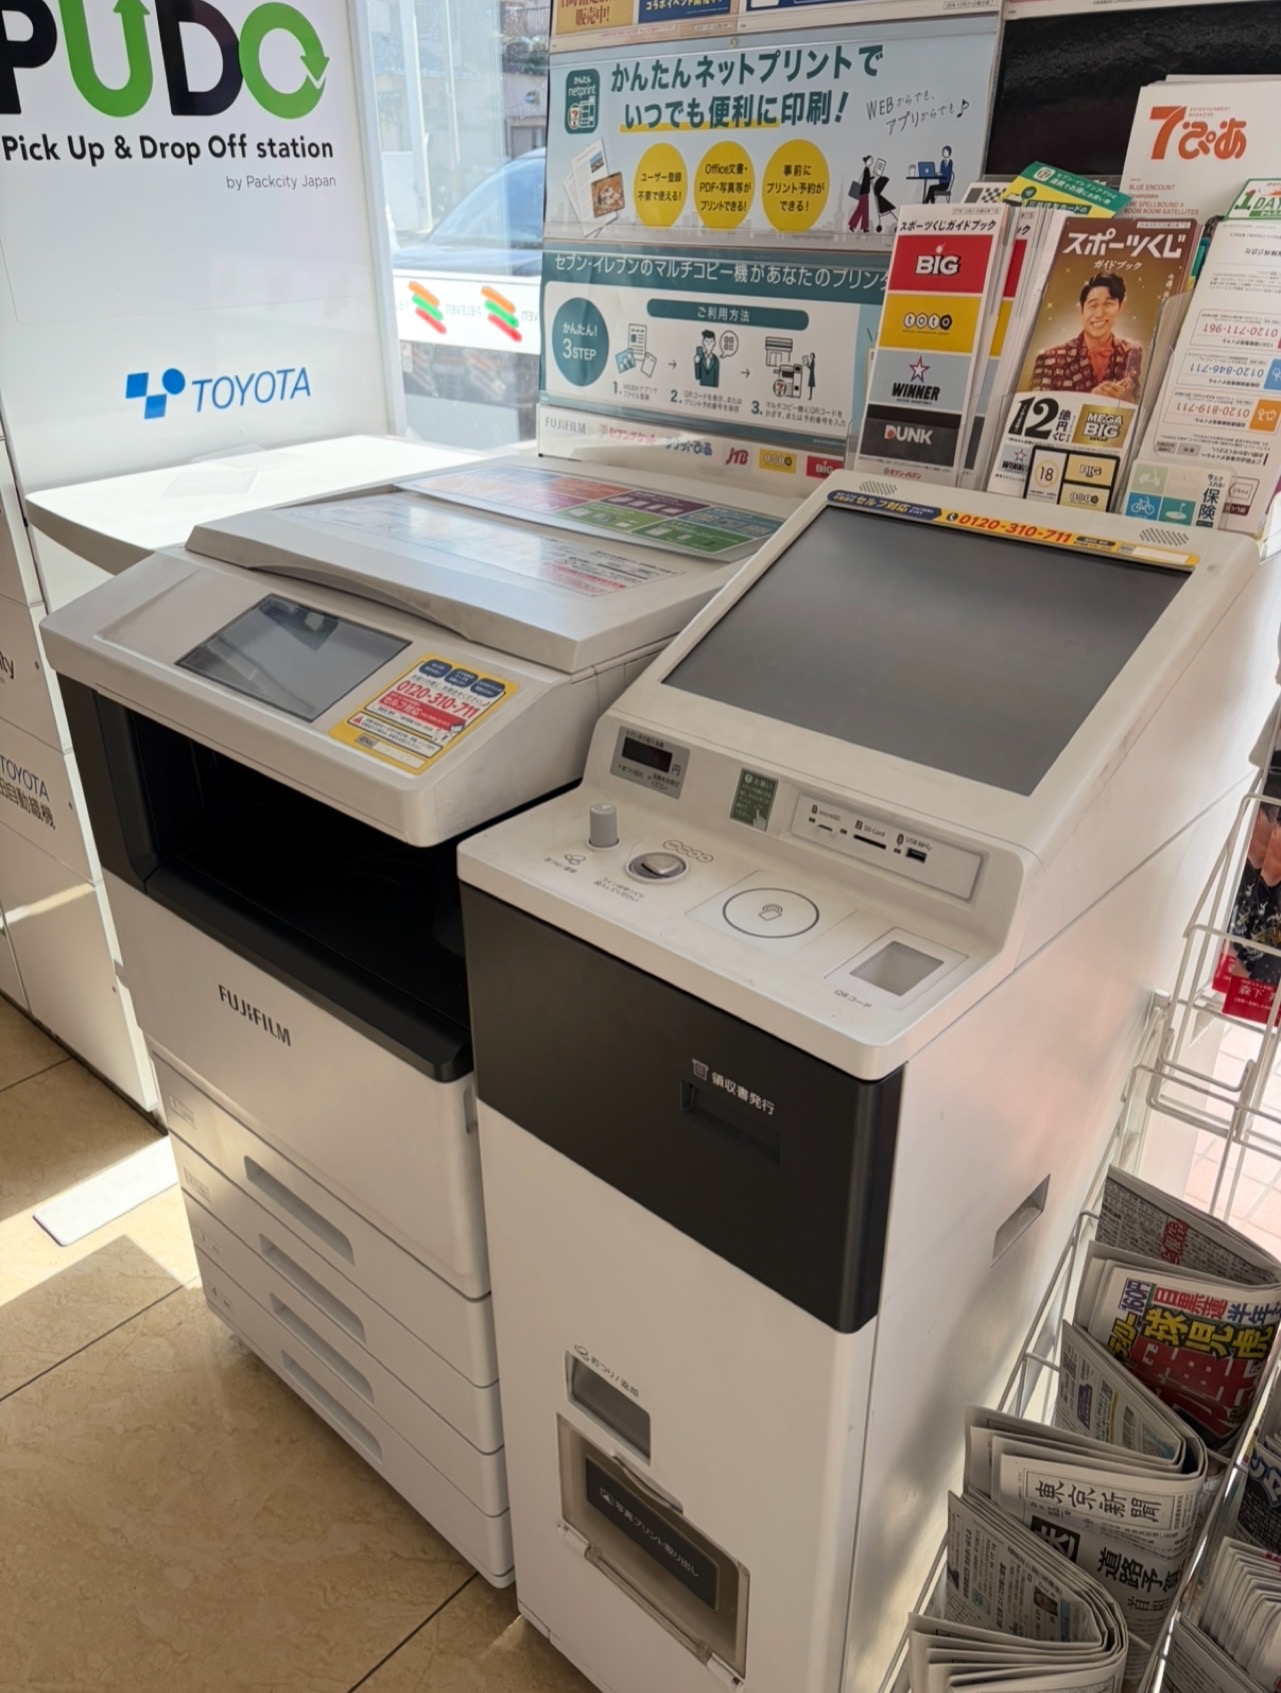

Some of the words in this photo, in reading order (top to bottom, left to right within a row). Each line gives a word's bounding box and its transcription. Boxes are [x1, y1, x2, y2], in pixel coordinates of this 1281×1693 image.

[611, 44, 884, 93] かんたんネットプリントで
[624, 90, 849, 130] いつでも便利に印刷!
[2, 135, 61, 161] Pick
[67, 135, 105, 166] Up
[114, 135, 133, 159] &
[140, 135, 201, 165] Drop
[207, 134, 248, 158] Off
[257, 136, 334, 158] station
[783, 164, 812, 177] 事前に
[226, 176, 243, 191] by
[246, 174, 298, 190] Packcity
[302, 174, 337, 189] Japan
[900, 219, 997, 232] スポーツくじガイドブック
[1062, 228, 1187, 259] スポーツくじ
[1093, 260, 1143, 271] ガイドブック
[697, 306, 750, 322] ご利用方法
[903, 311, 953, 331] toto
[191, 366, 312, 412] TOYOTA
[891, 382, 940, 401] WINNER
[545, 416, 586, 434] FUJIFILM
[1008, 396, 1059, 440] 12
[1086, 412, 1124, 425] MEGA
[884, 424, 934, 445] DUNK
[1083, 422, 1121, 439] BIG
[725, 447, 749, 465] JTB
[1040, 466, 1054, 481] 18
[1198, 488, 1220, 521] 保険
[958, 514, 1072, 543] 0120-310-711
[396, 679, 480, 719] 0120-310-711
[0, 755, 50, 802] TOYOTA
[672, 763, 682, 777] 円
[834, 988, 872, 1009] QRコード
[218, 983, 291, 1047] FUJIFILM
[712, 1071, 775, 1115] 領収書発行
[1035, 1479, 1162, 1523] 東京新聞
